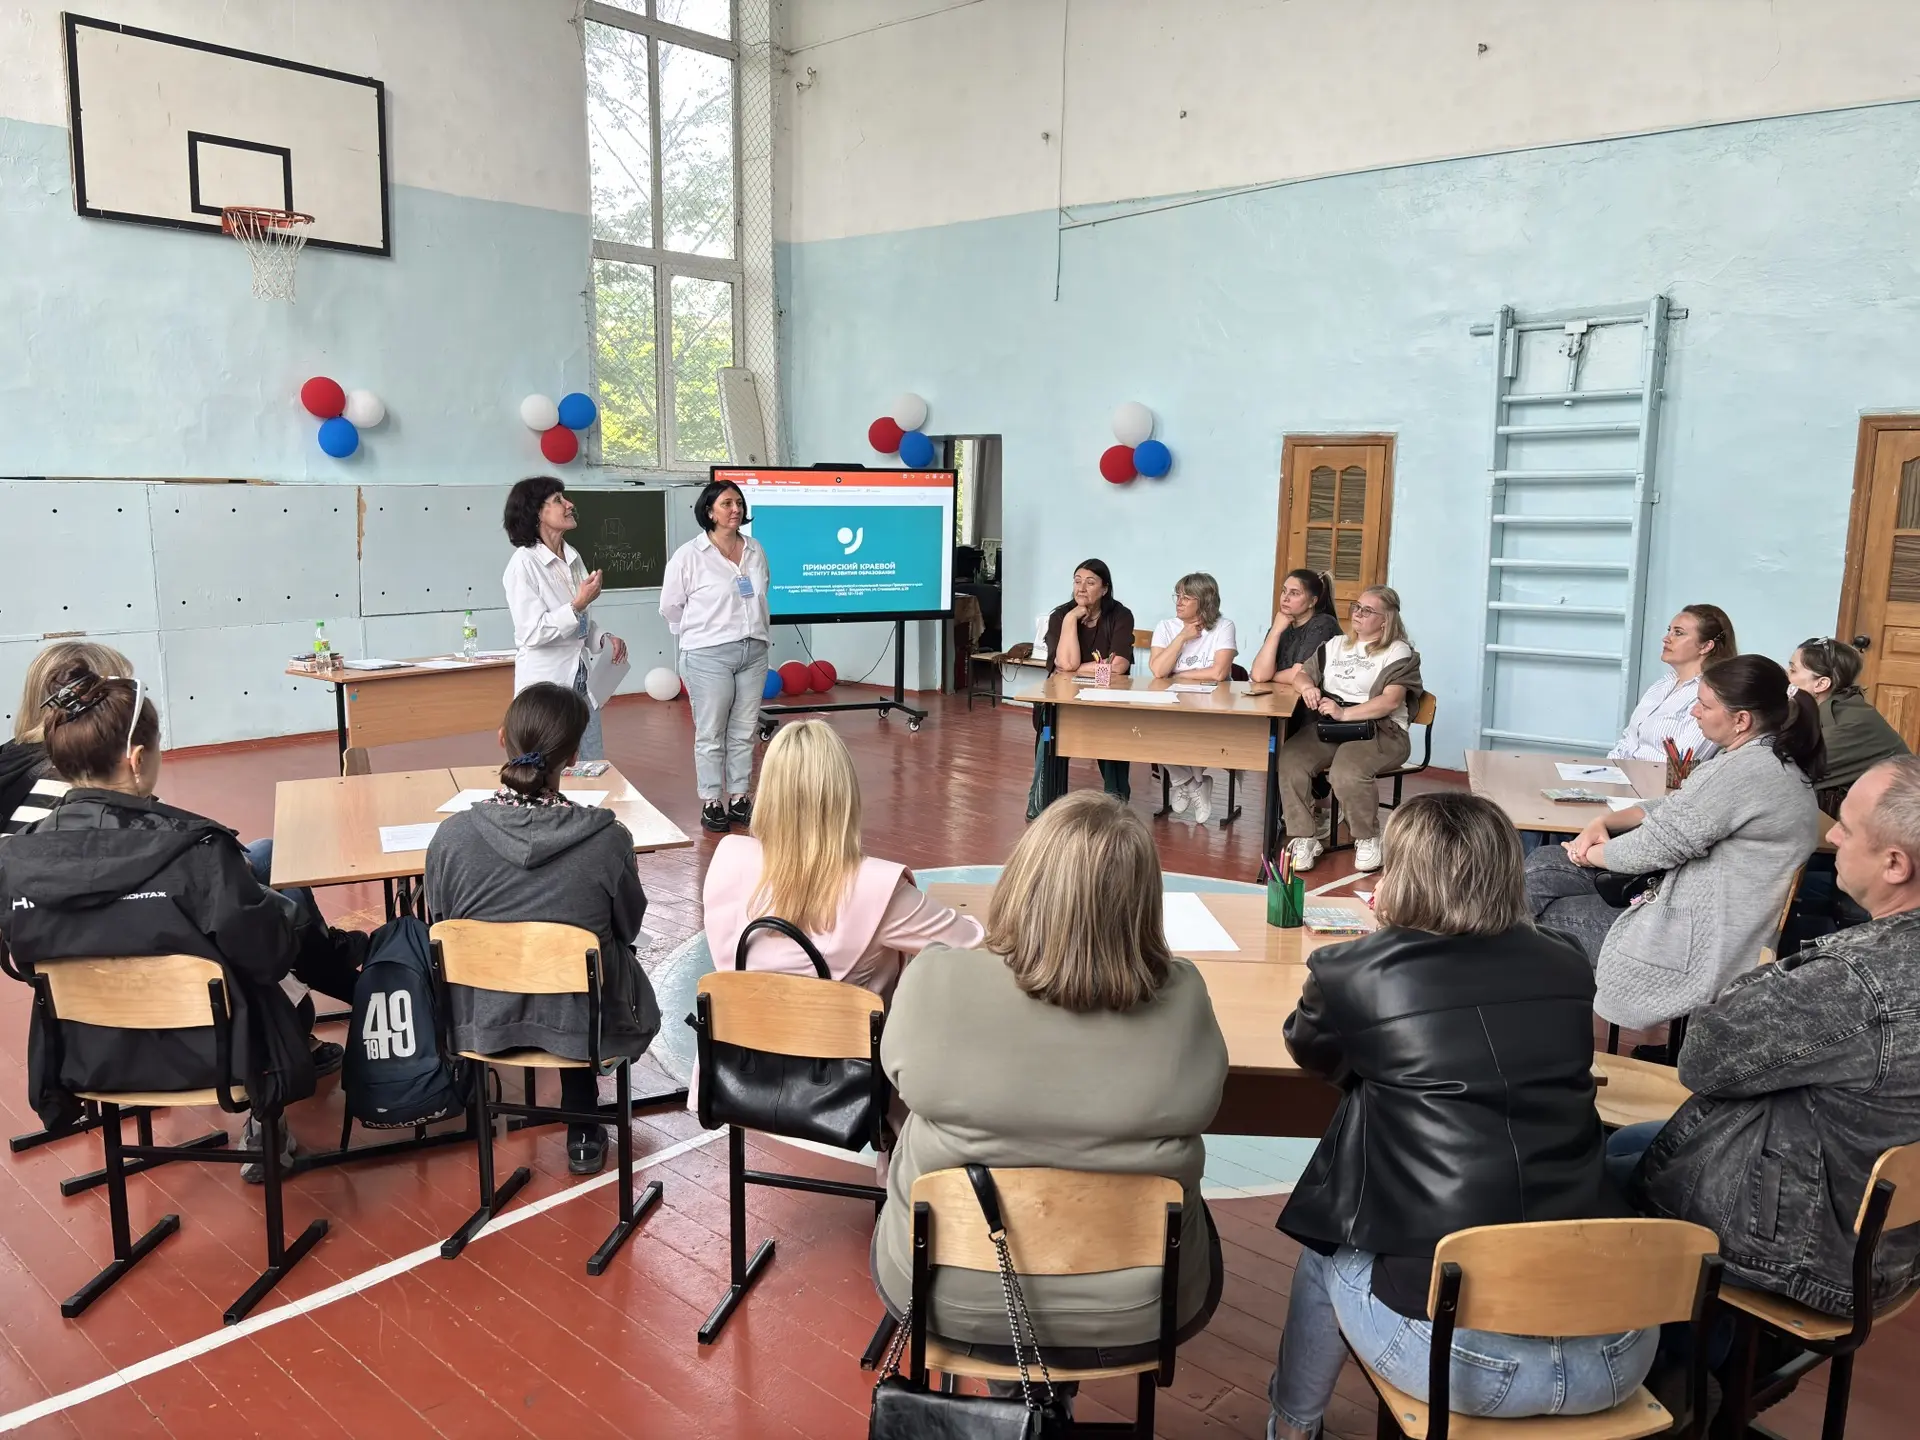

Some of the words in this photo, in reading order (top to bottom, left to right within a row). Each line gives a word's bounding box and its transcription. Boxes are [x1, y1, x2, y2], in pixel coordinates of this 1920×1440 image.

[802, 562, 858, 571] ПРИМОРСКИЙ
[860, 561, 896, 570] КРАЕВОЙ
[362, 989, 417, 1059] 49
[363, 1039, 380, 1061] 19
